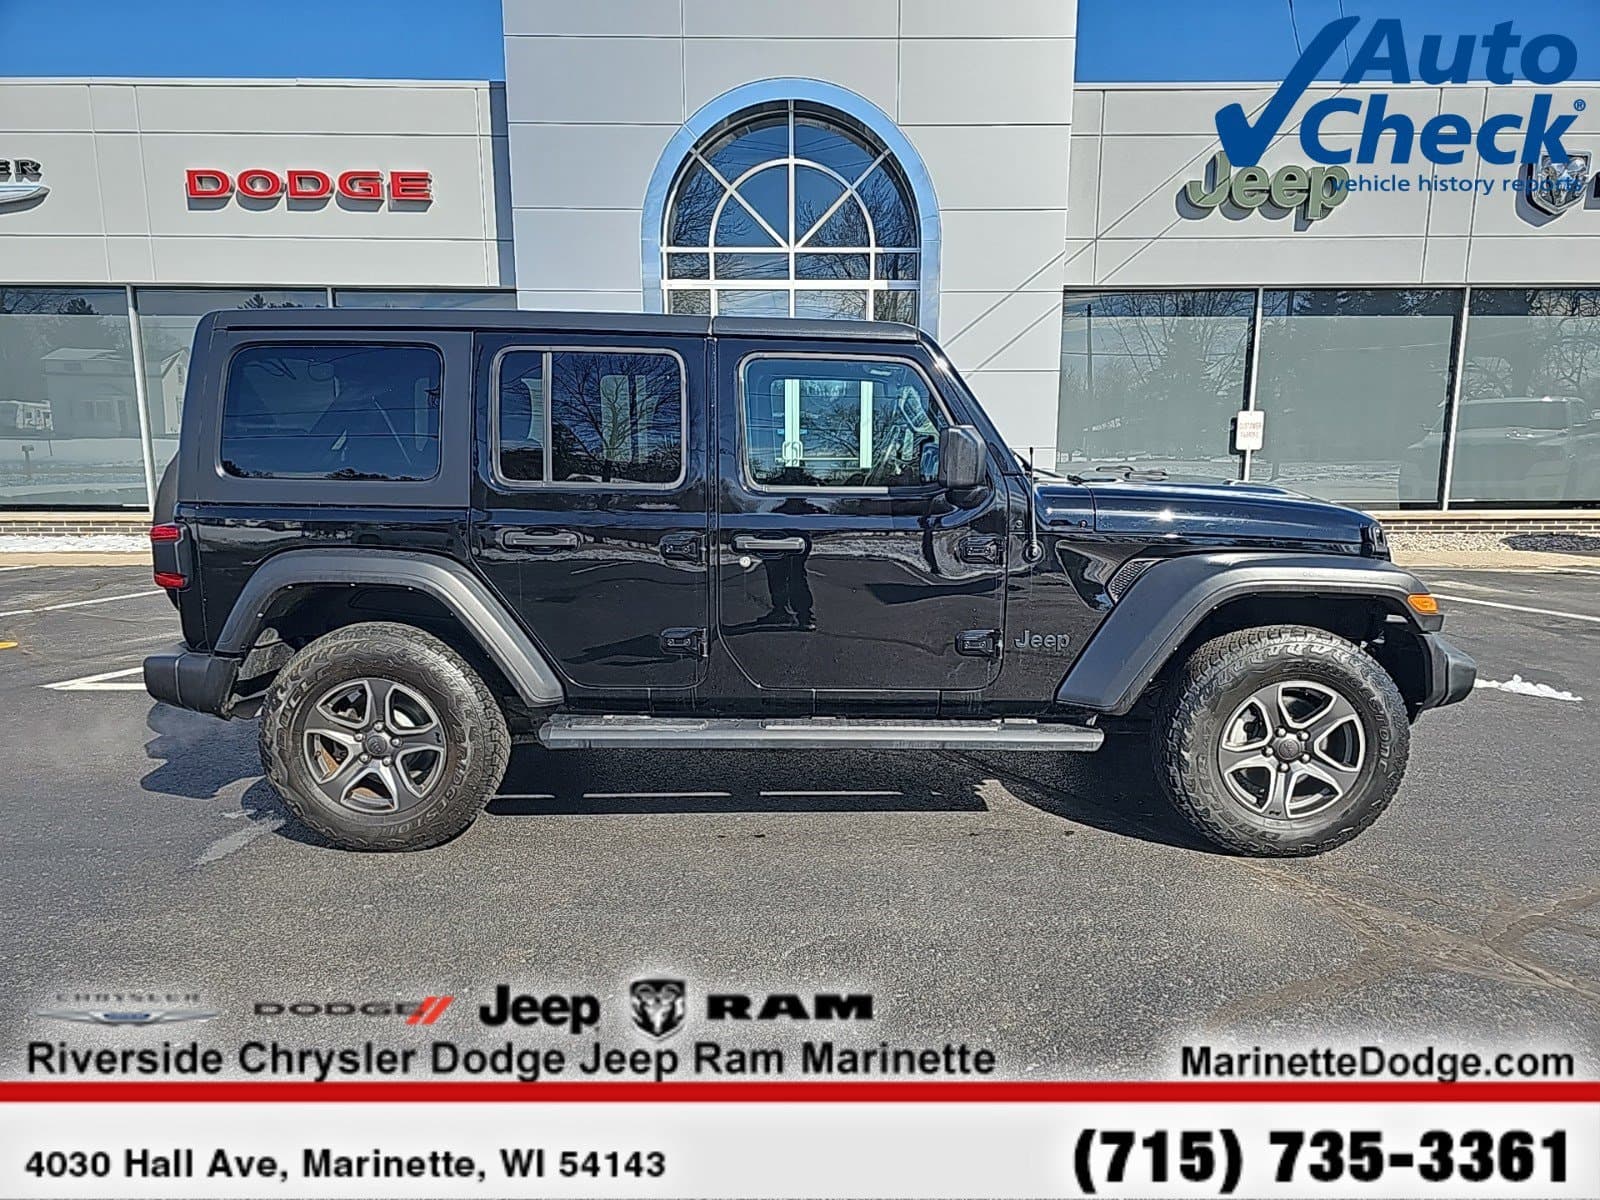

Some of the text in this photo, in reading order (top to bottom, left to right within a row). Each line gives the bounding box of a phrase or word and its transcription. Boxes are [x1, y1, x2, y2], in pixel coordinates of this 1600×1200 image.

[185, 168, 434, 204] DODGE
[1182, 151, 1350, 221] Jeep
[1014, 629, 1071, 651] Jeep
